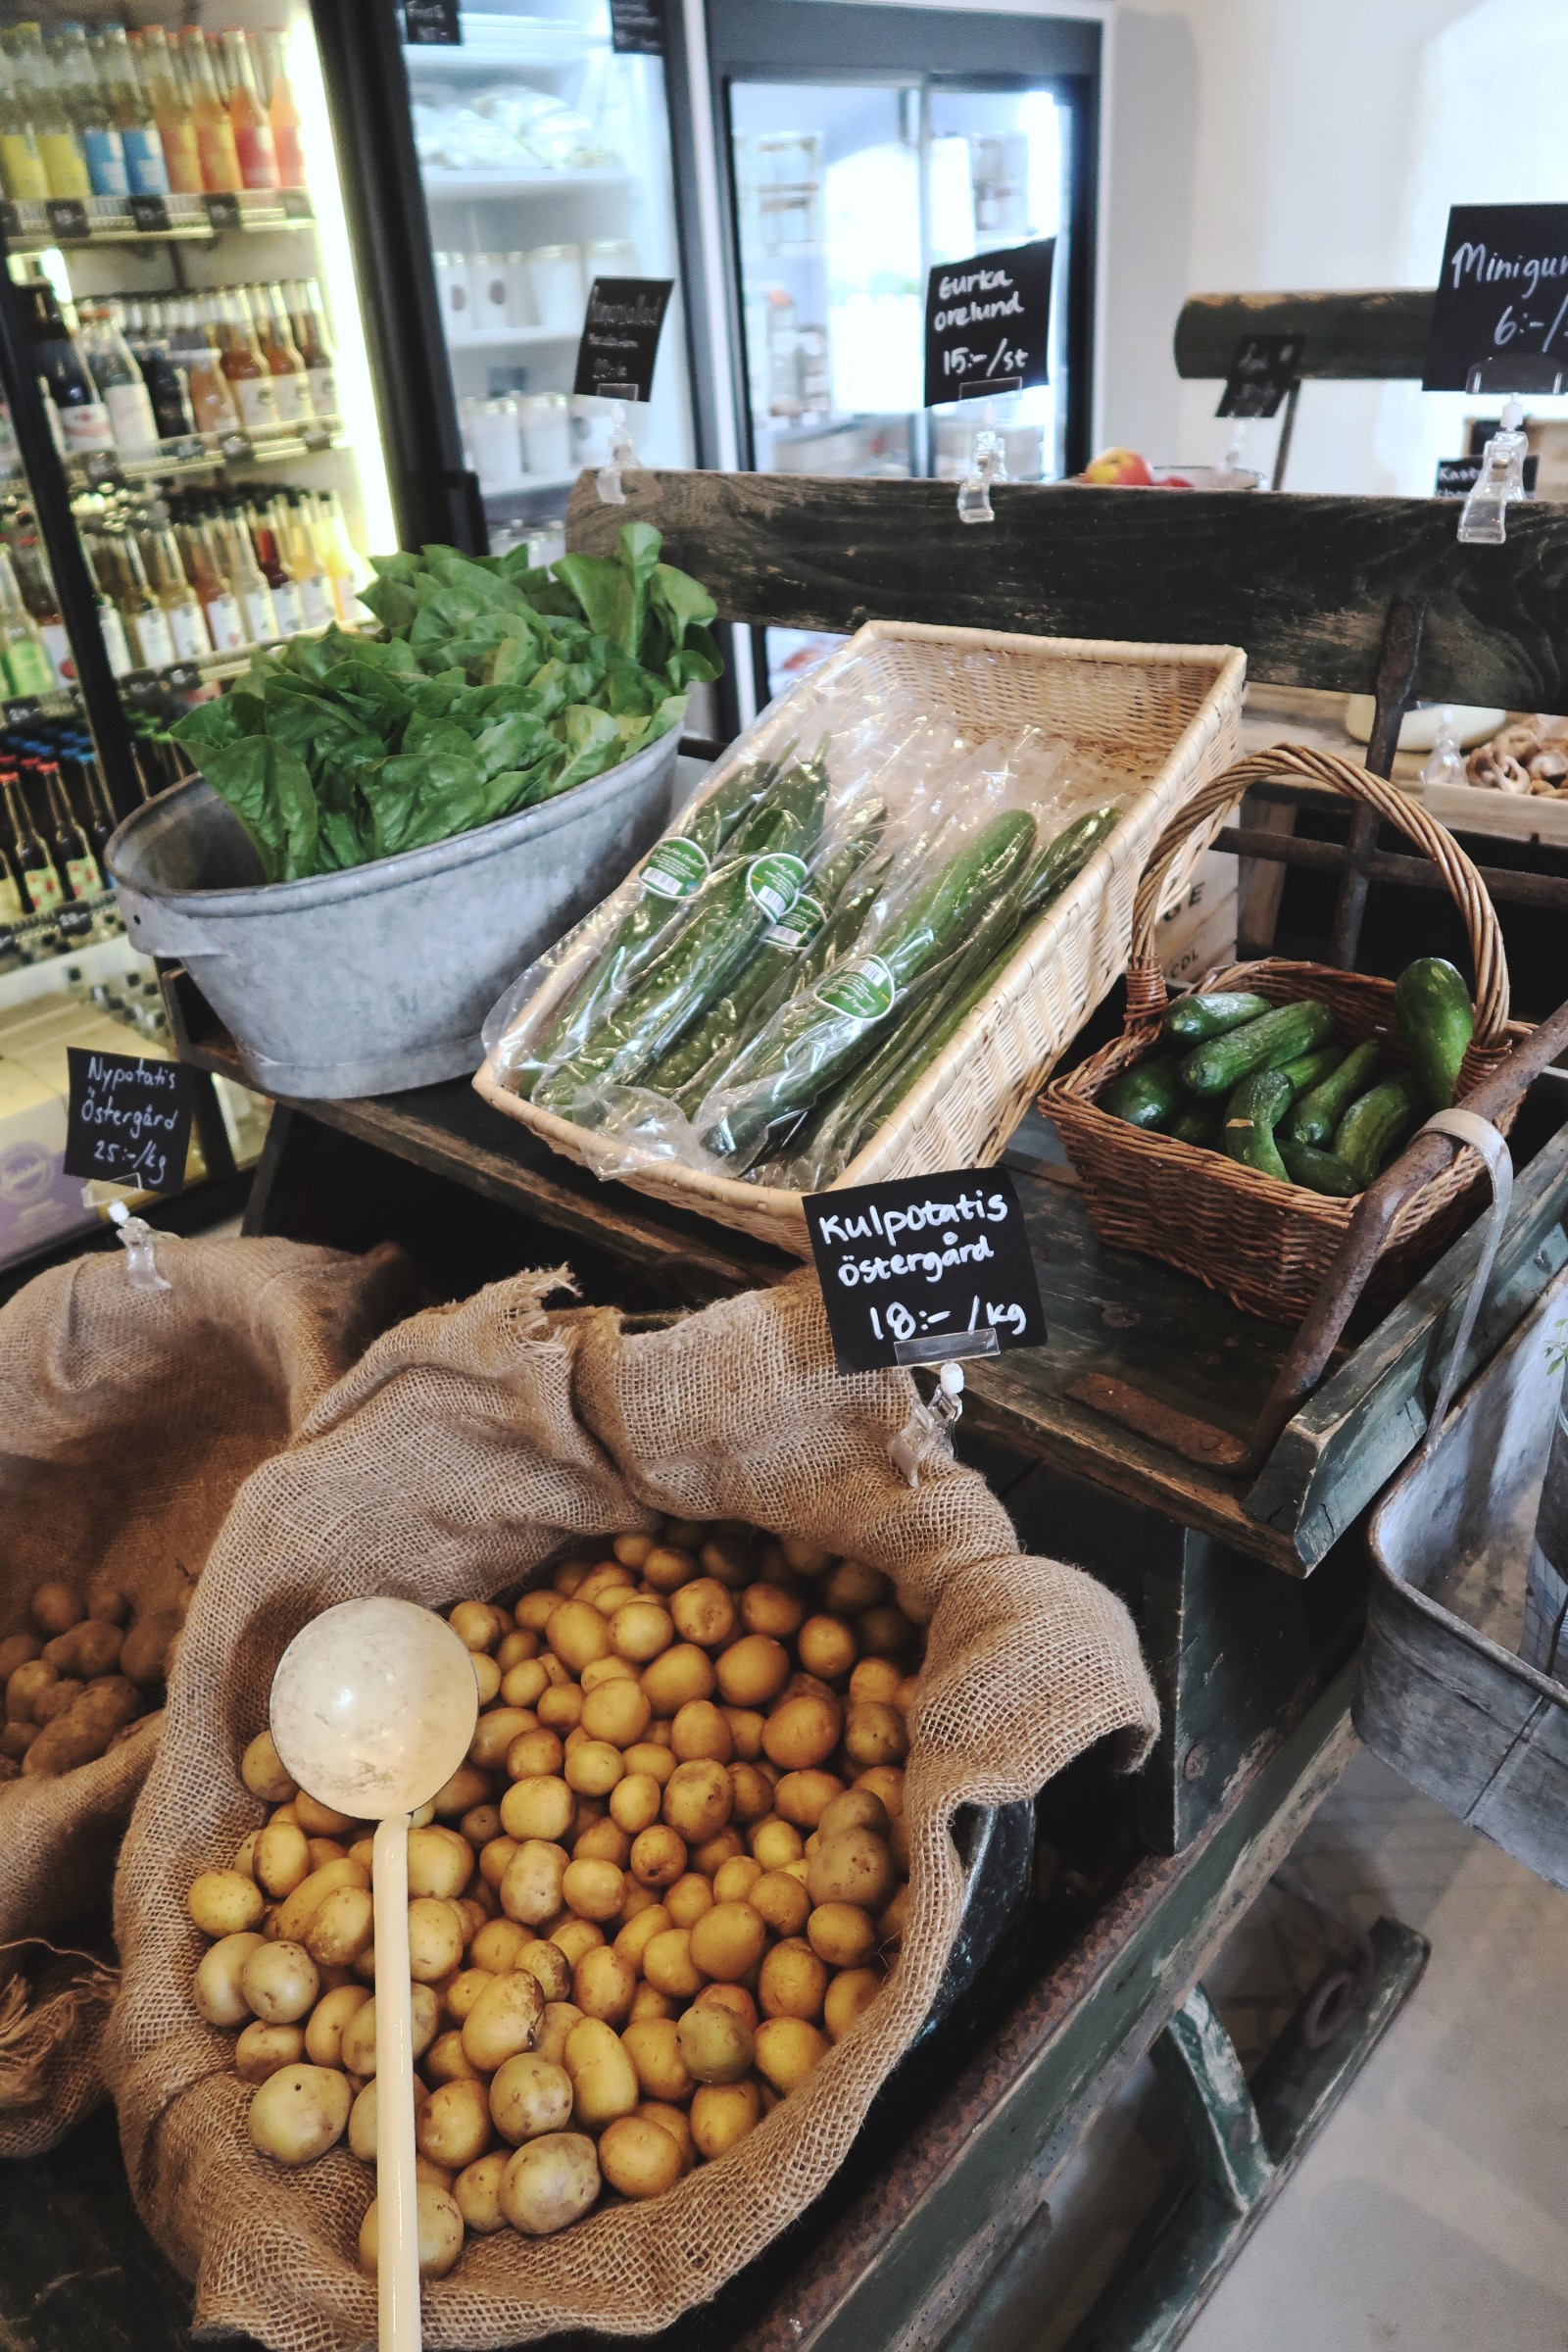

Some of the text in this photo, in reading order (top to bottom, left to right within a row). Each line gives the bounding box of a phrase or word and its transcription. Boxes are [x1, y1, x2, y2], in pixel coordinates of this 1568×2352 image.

[87, 1055, 175, 1093] Nypotatis
[80, 1085, 179, 1140] Östergård
[818, 1189, 1008, 1248] Kulpotatis
